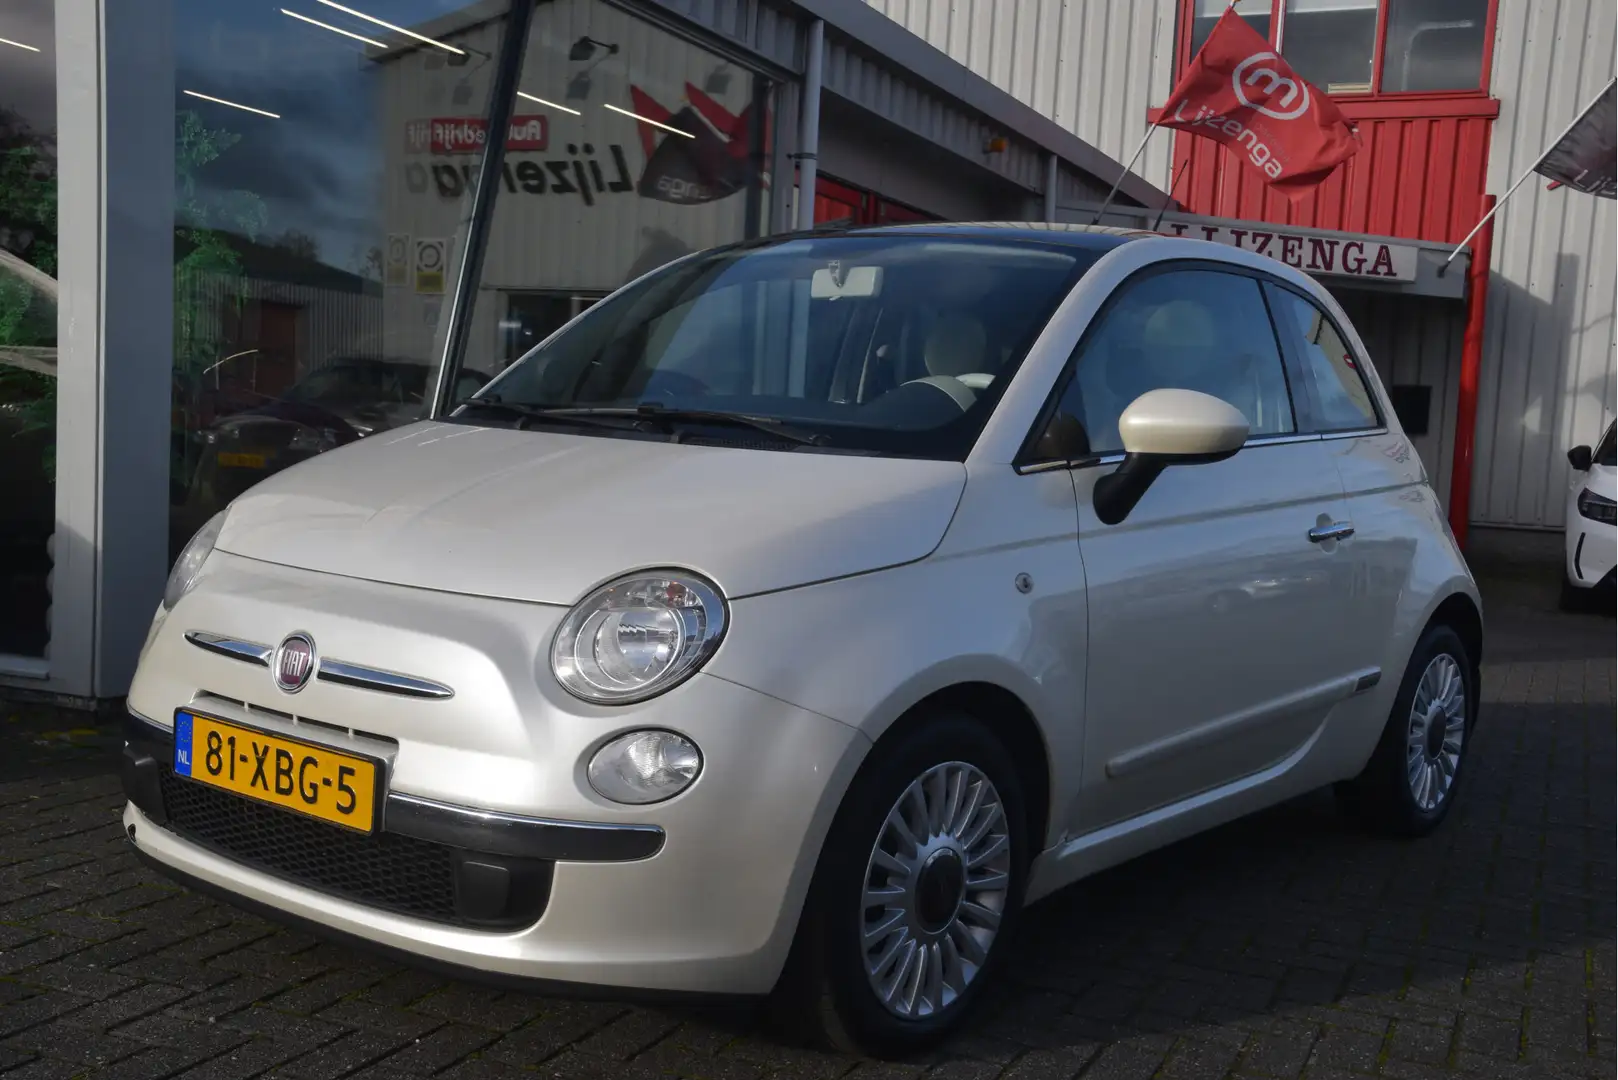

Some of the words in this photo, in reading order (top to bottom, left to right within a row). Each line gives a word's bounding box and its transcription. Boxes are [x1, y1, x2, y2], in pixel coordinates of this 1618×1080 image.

[1174, 99, 1283, 179] Lijzenga
[283, 650, 307, 677] FIAT
[177, 749, 190, 765] NL
[205, 730, 357, 815] 81-XBG-5
